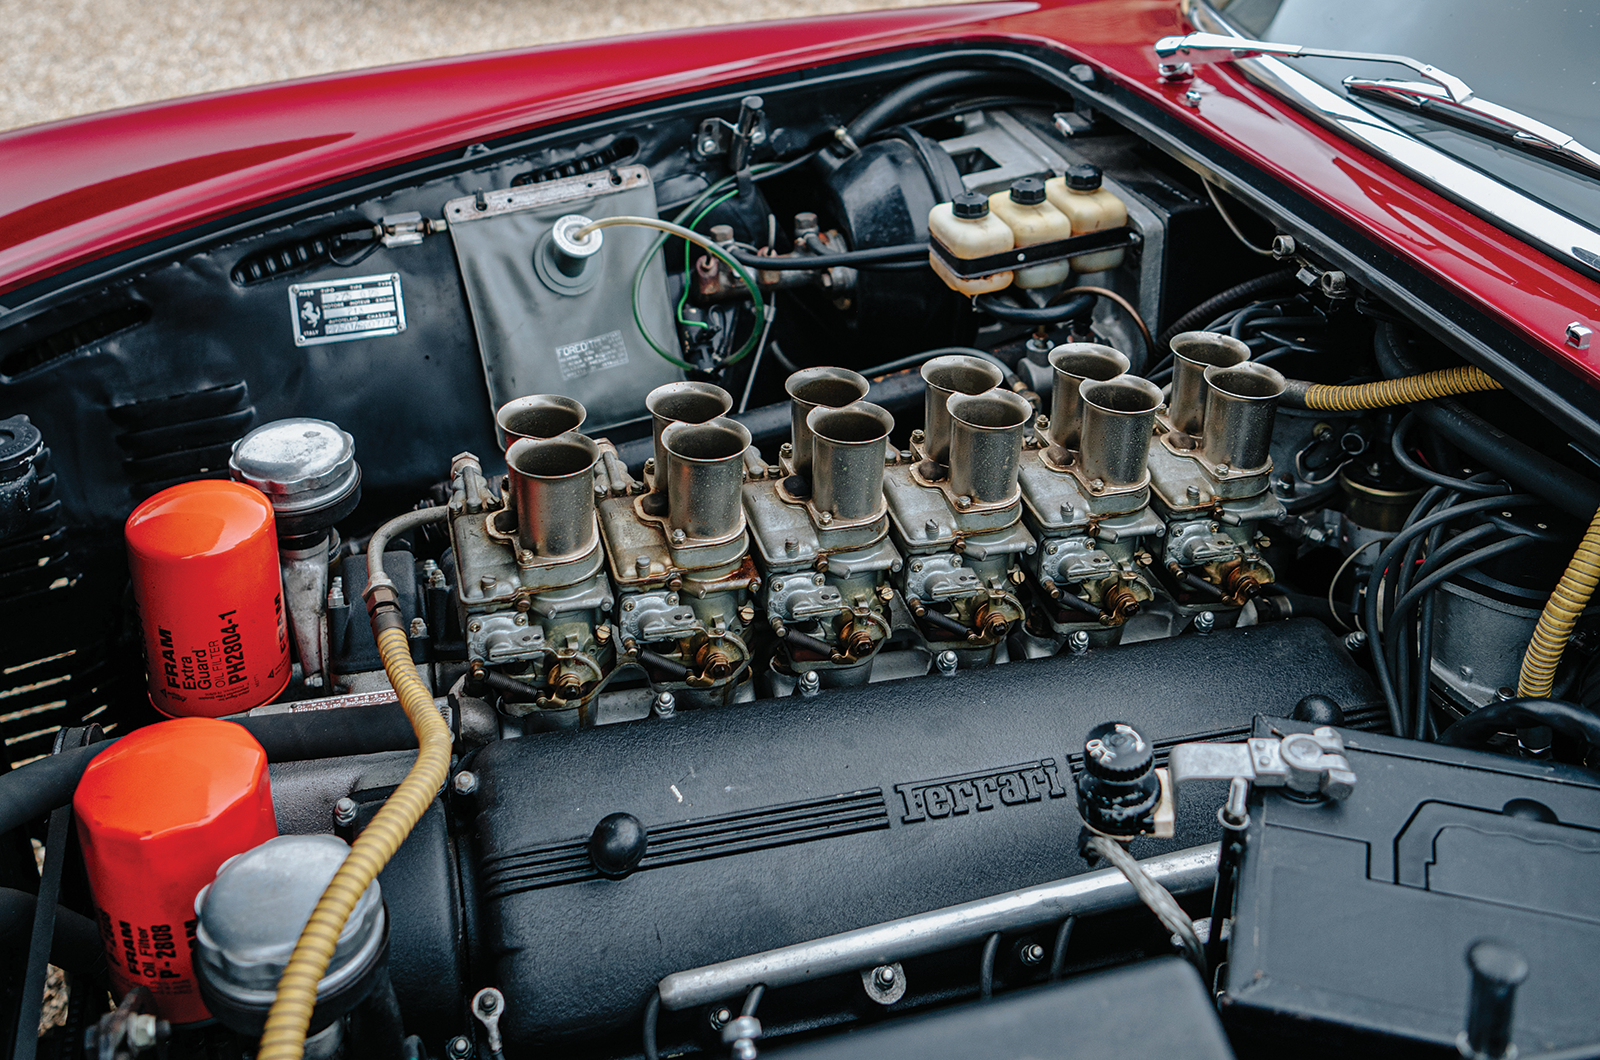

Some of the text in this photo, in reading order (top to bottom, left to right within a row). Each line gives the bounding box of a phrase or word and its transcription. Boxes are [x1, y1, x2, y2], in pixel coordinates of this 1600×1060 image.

[303, 329, 319, 337] ITALY
[218, 610, 248, 686] PH2804-1
[274, 592, 287, 654] FRAM
[158, 627, 181, 689] FRAM
[181, 656, 197, 690] Extra
[192, 649, 212, 690] Guard
[208, 639, 226, 688] OIL FILTER
[1086, 738, 1117, 765] OFF
[894, 758, 1067, 825] Ferrari
[119, 920, 141, 976] FRAM
[137, 925, 157, 978] Oil Filter
